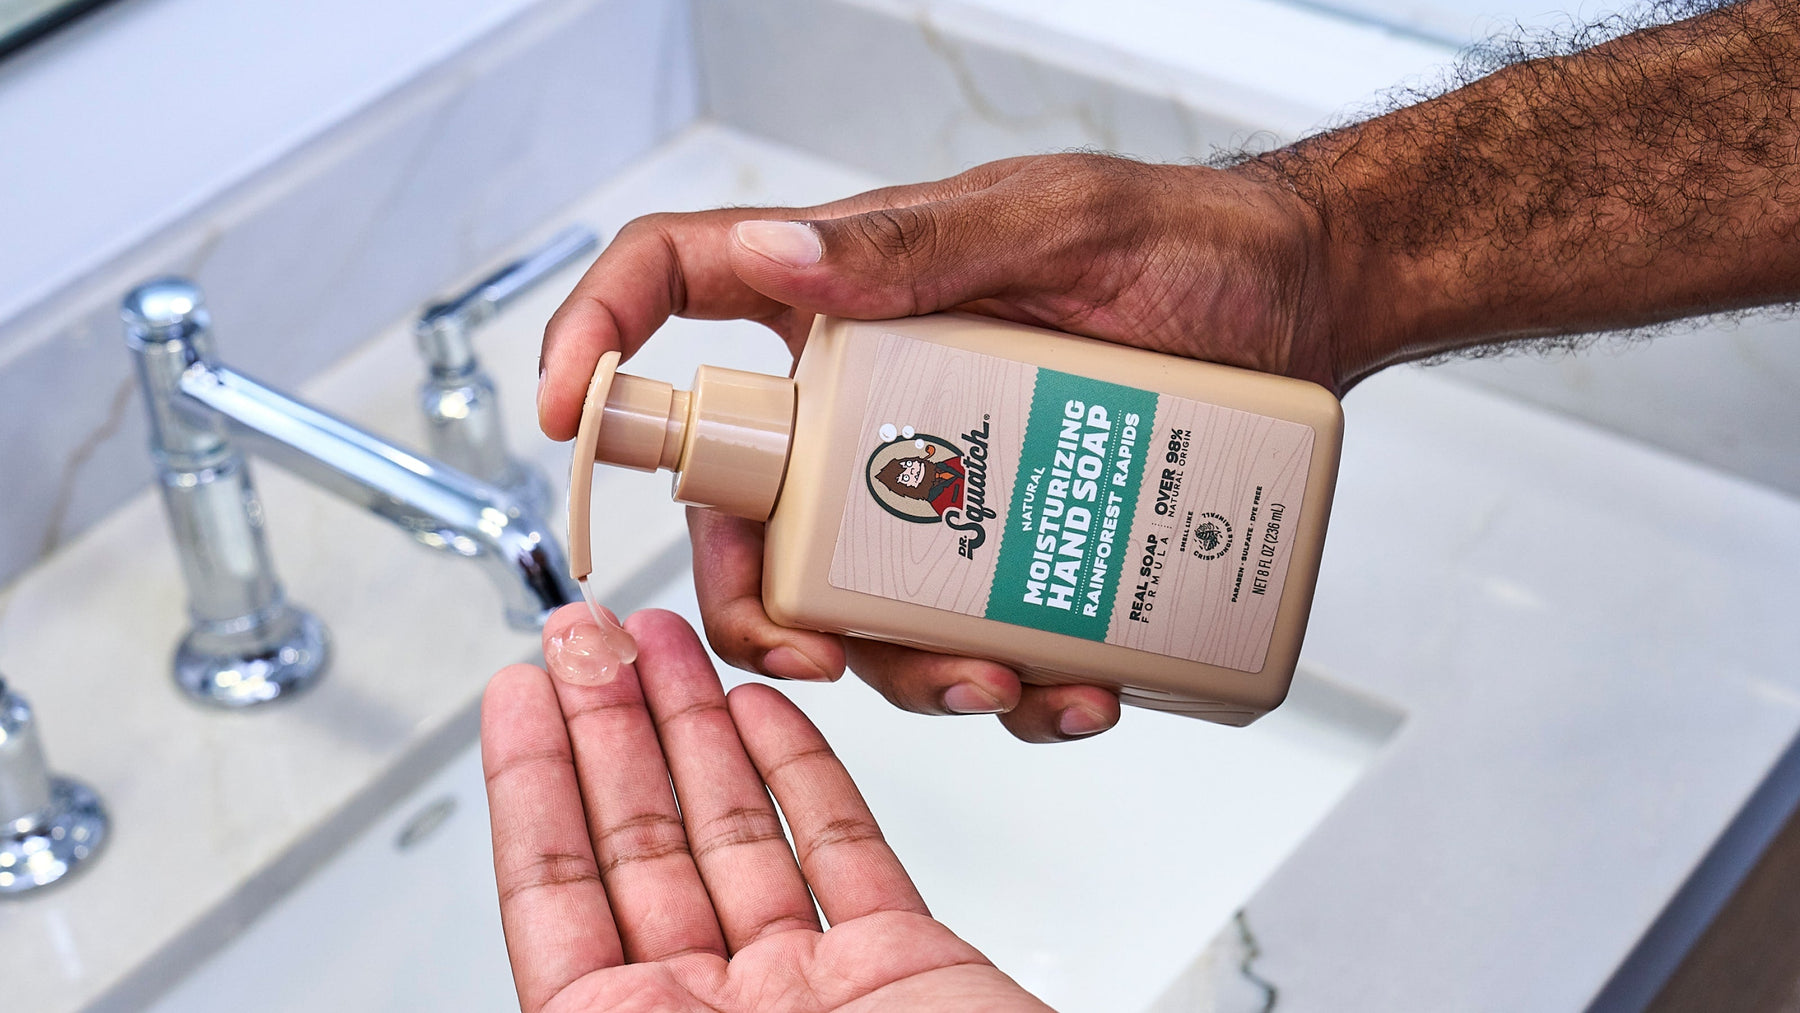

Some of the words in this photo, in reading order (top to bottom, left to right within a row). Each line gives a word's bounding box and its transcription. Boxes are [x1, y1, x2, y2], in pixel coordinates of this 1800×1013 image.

[1154, 468, 1176, 516] OVER
[1166, 428, 1183, 464] 98%
[1168, 471, 1184, 517] NATURAL
[1178, 430, 1192, 466] ORIGIN
[945, 421, 997, 560] Squatch
[1022, 467, 1046, 532] NATURAL
[1023, 400, 1085, 606] MOISTURIZING
[1253, 486, 1263, 505] FREE
[1046, 506, 1092, 611] HAND
[1072, 405, 1112, 502] SOAP
[1082, 491, 1123, 617] RAINFOREST
[1112, 412, 1140, 487] RAPIDS
[1202, 512, 1232, 532] RAINFALL
[1250, 506, 1258, 521] DYE
[1271, 503, 1286, 521] mL)
[958, 535, 968, 557] DR.
[1180, 529, 1189, 552] SMELL
[1185, 511, 1193, 528] LIKE
[1216, 534, 1233, 558] JUNGLE
[1241, 527, 1254, 562] SULFATE
[1264, 522, 1280, 544] (236
[1193, 550, 1215, 560] CRISP
[1259, 559, 1272, 569] FL
[1261, 544, 1275, 557] OZ
[1129, 581, 1149, 621] REAL
[1140, 534, 1158, 577] SOAP
[1141, 537, 1169, 624] FORMULA
[1231, 567, 1244, 602] PARABEN
[1252, 577, 1267, 595] NET
[1257, 569, 1269, 577] 8
